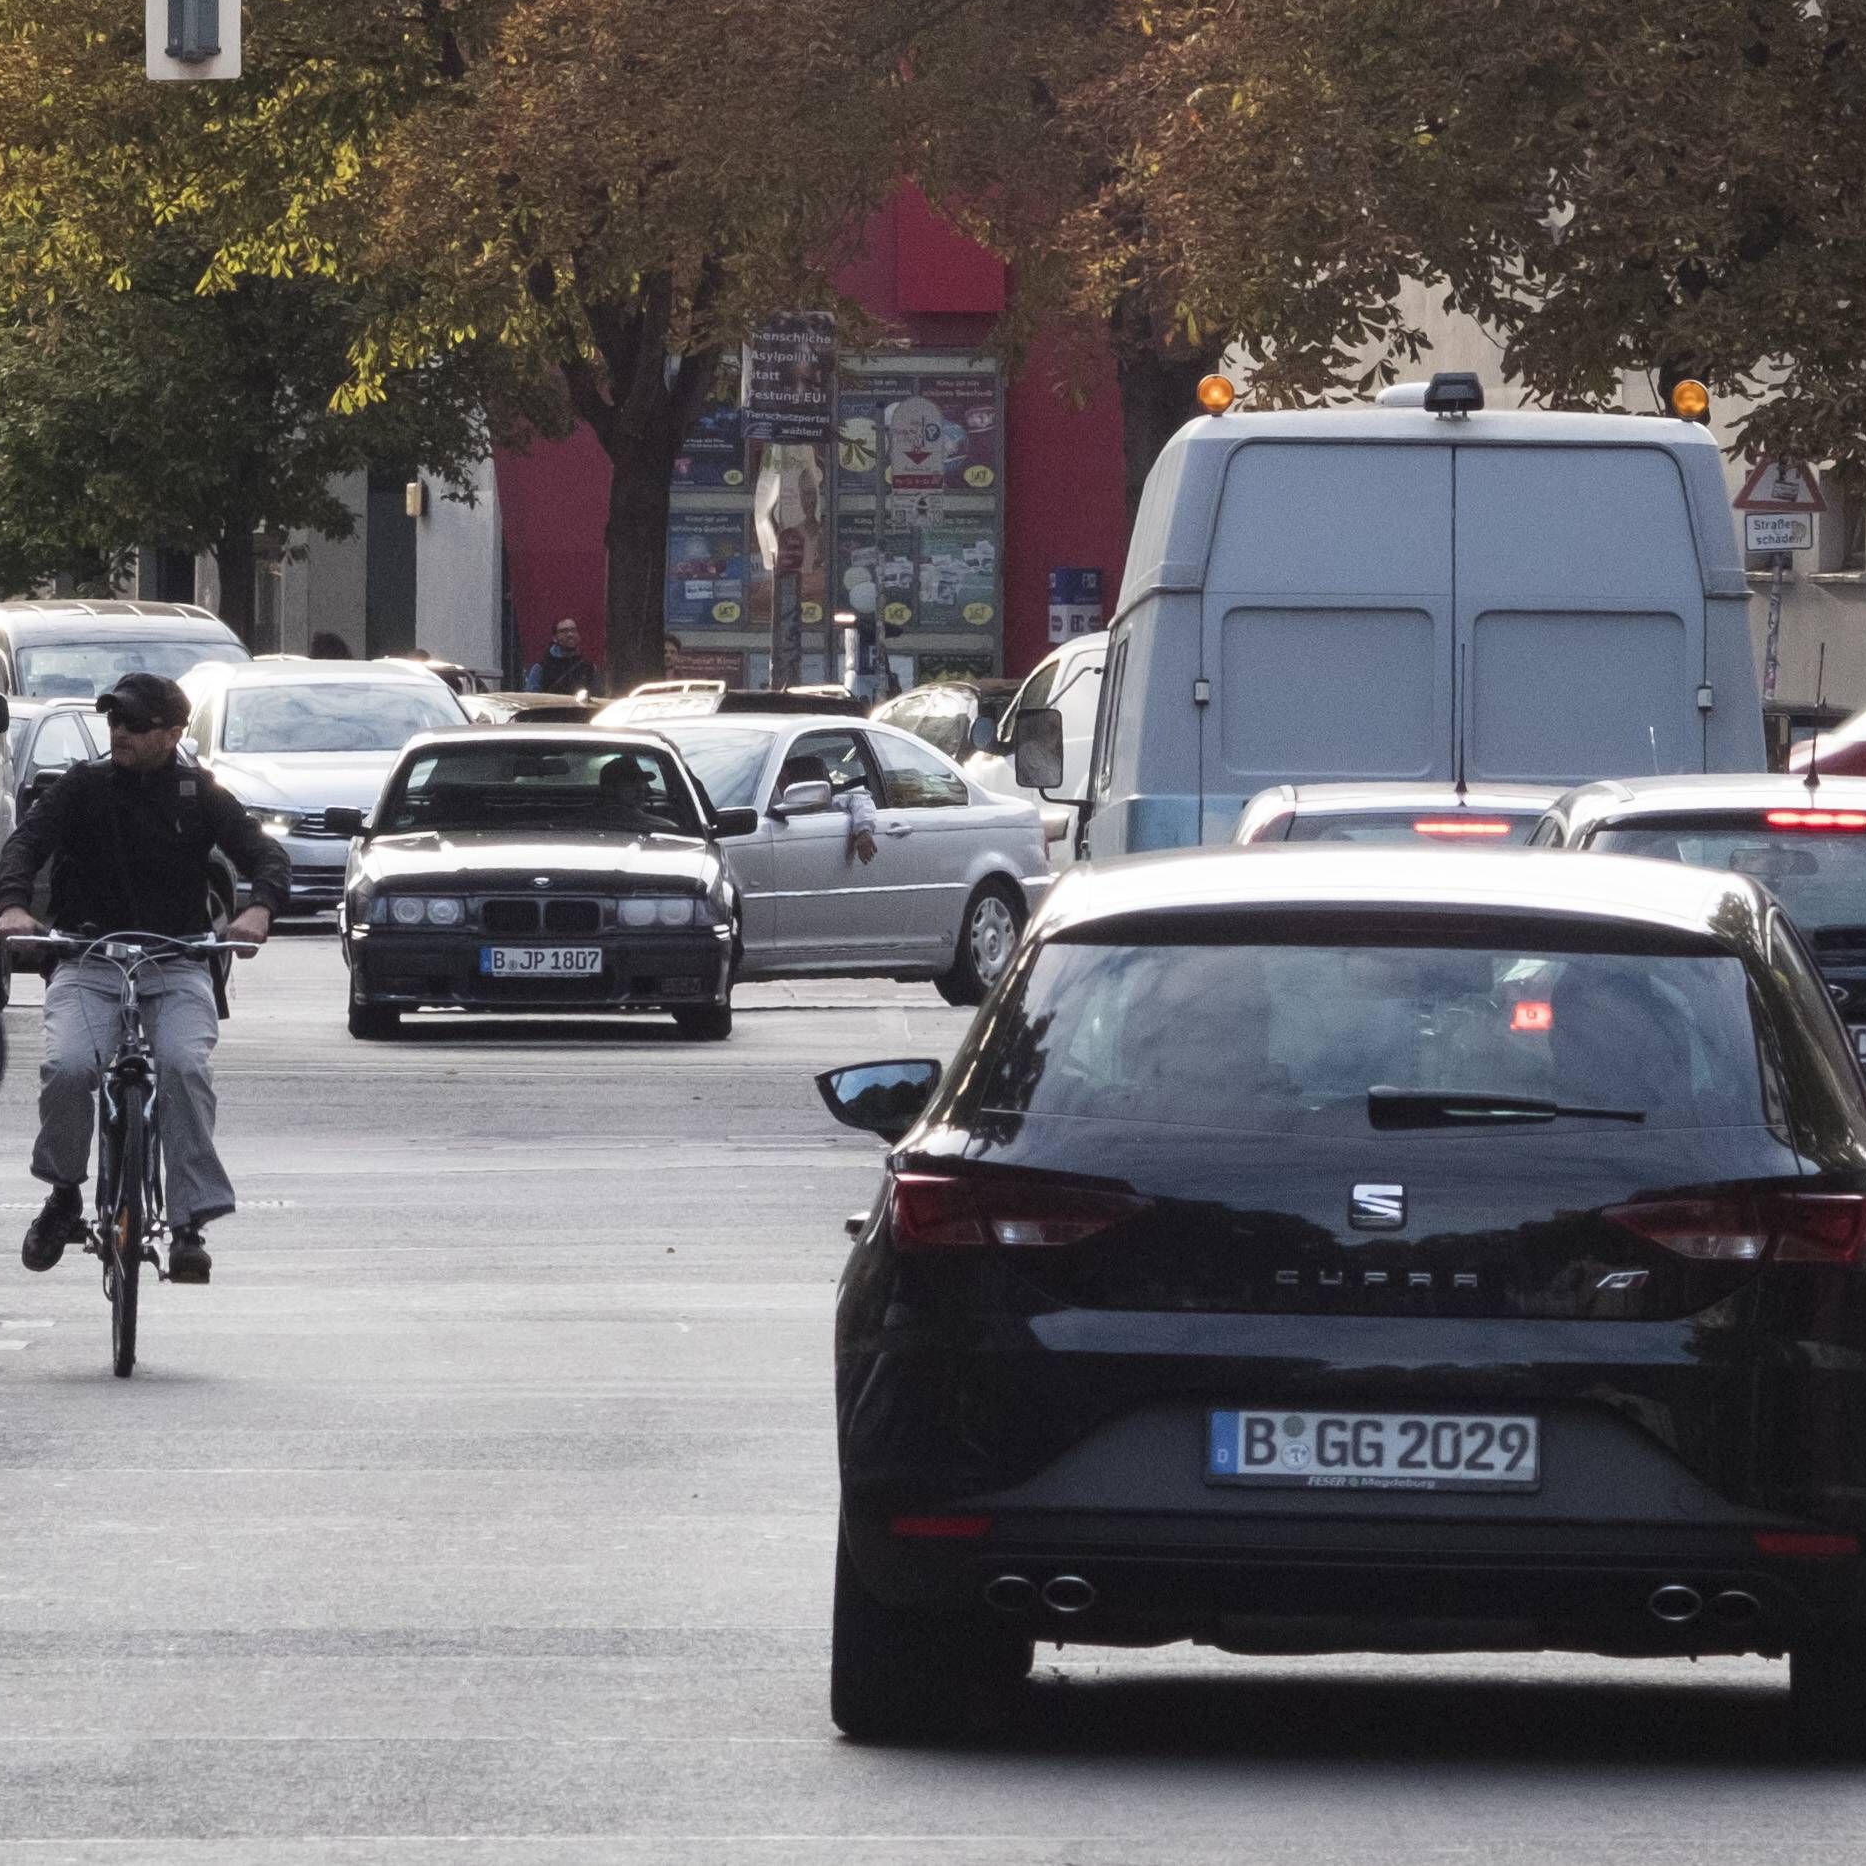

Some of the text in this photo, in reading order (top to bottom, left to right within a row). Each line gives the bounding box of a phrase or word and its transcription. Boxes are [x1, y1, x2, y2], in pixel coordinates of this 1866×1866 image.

[751, 351, 819, 363] Asylpolitik
[494, 951, 600, 970] B JP 1807
[1275, 1269, 1478, 1288] CUPRA
[1244, 1417, 1277, 1466] B
[1316, 1419, 1384, 1468] GG
[1397, 1420, 1530, 1471] 2029
[1361, 1477, 1435, 1489] Magdeburg
